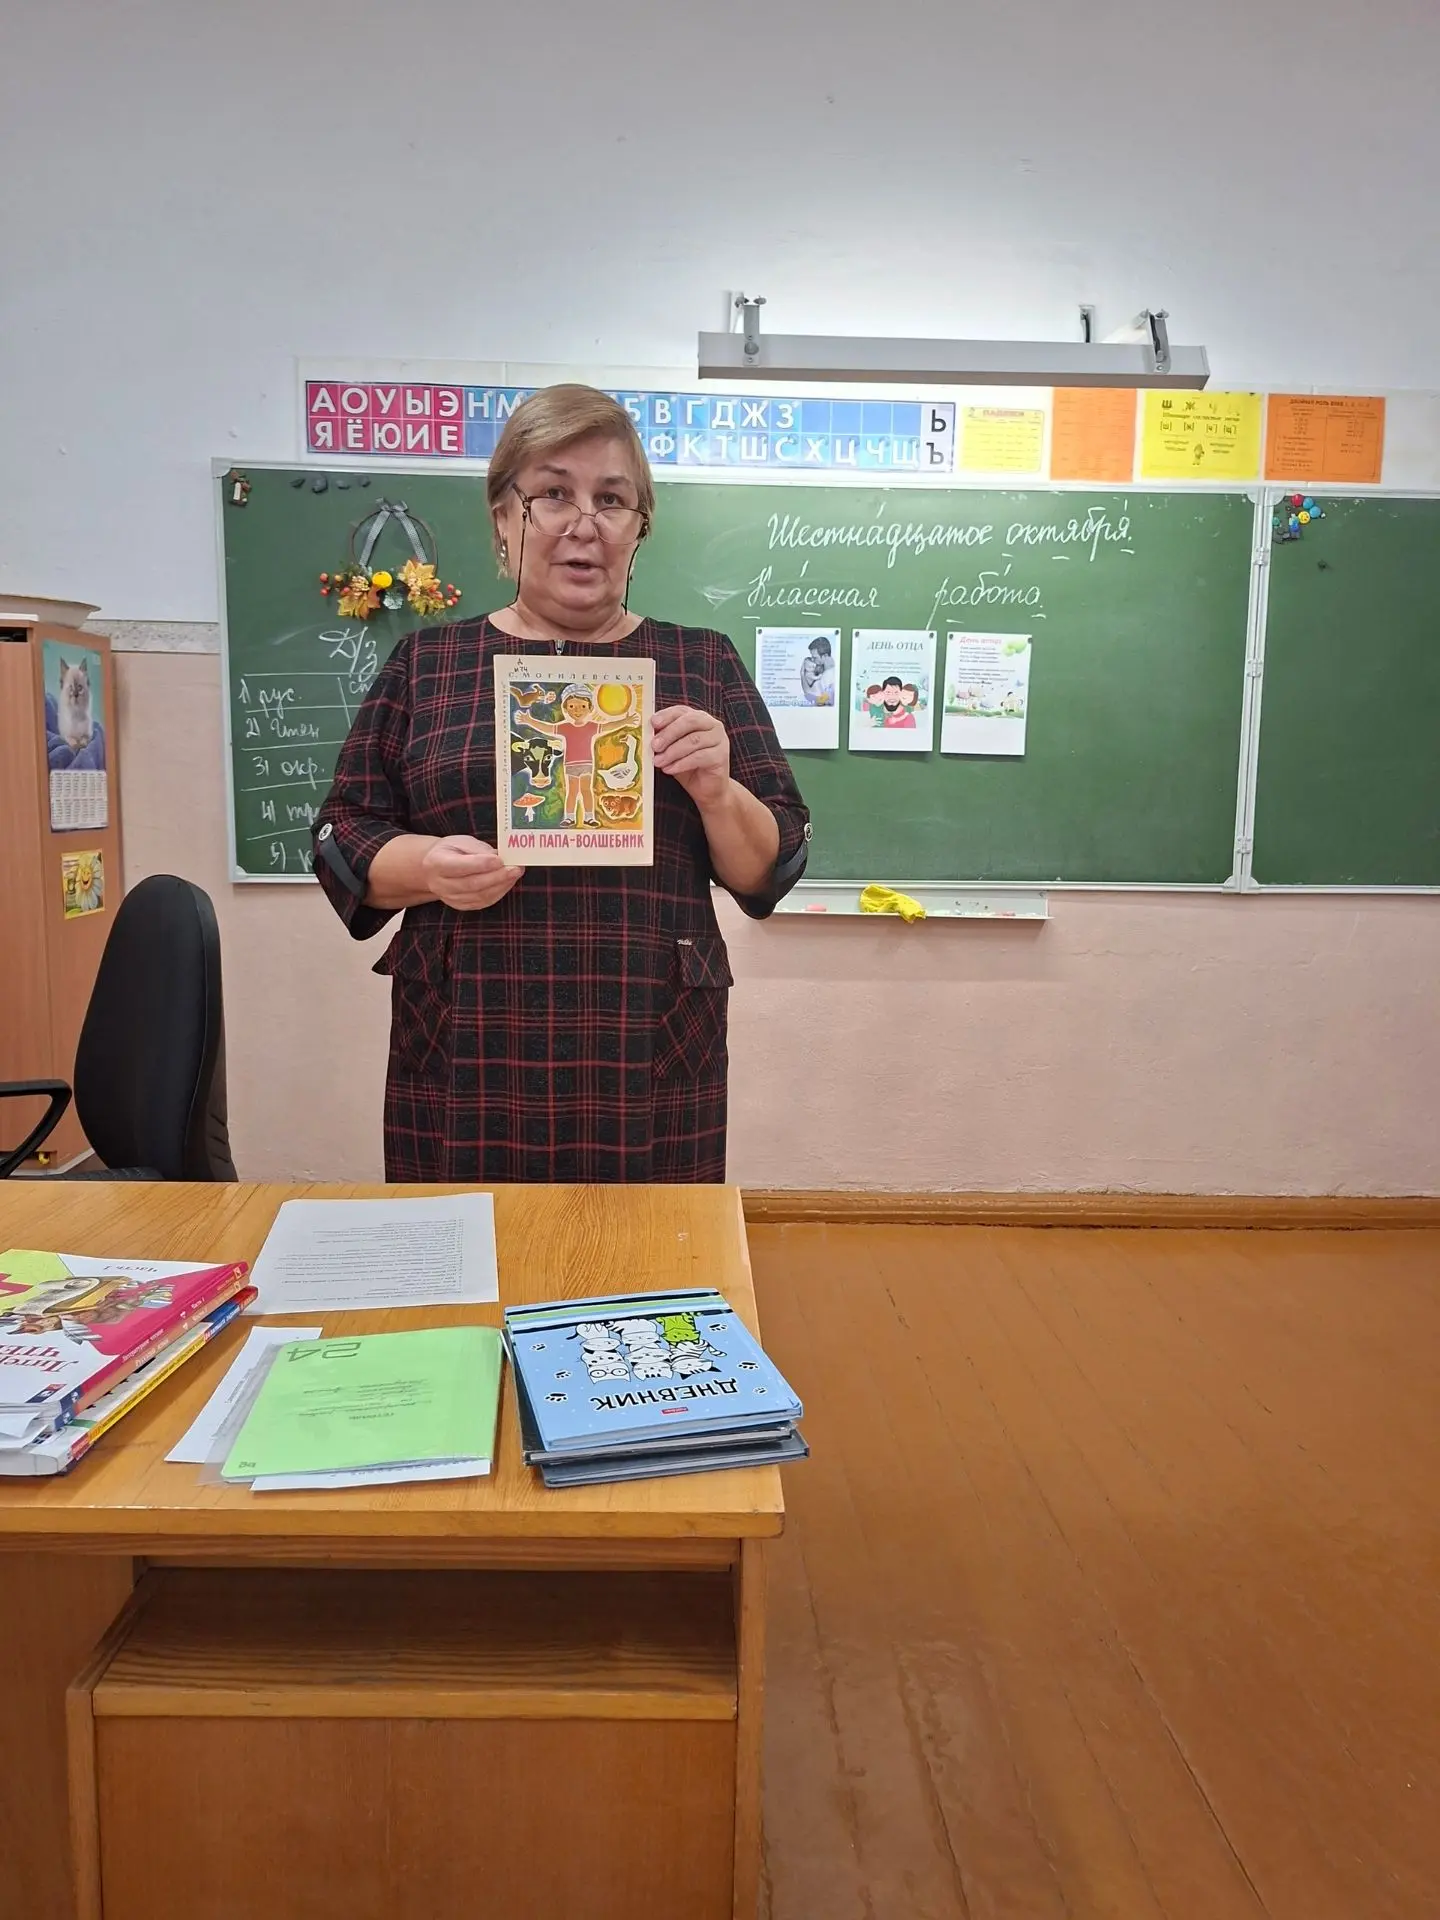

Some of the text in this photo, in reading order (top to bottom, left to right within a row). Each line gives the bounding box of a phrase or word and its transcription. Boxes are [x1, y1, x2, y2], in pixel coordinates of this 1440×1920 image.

[507, 832, 645, 849] МОЙ ПАПА-ВОЛШЕБНИК
[286, 1341, 362, 1364] 24
[590, 1377, 739, 1412] ДНЕВНИК
